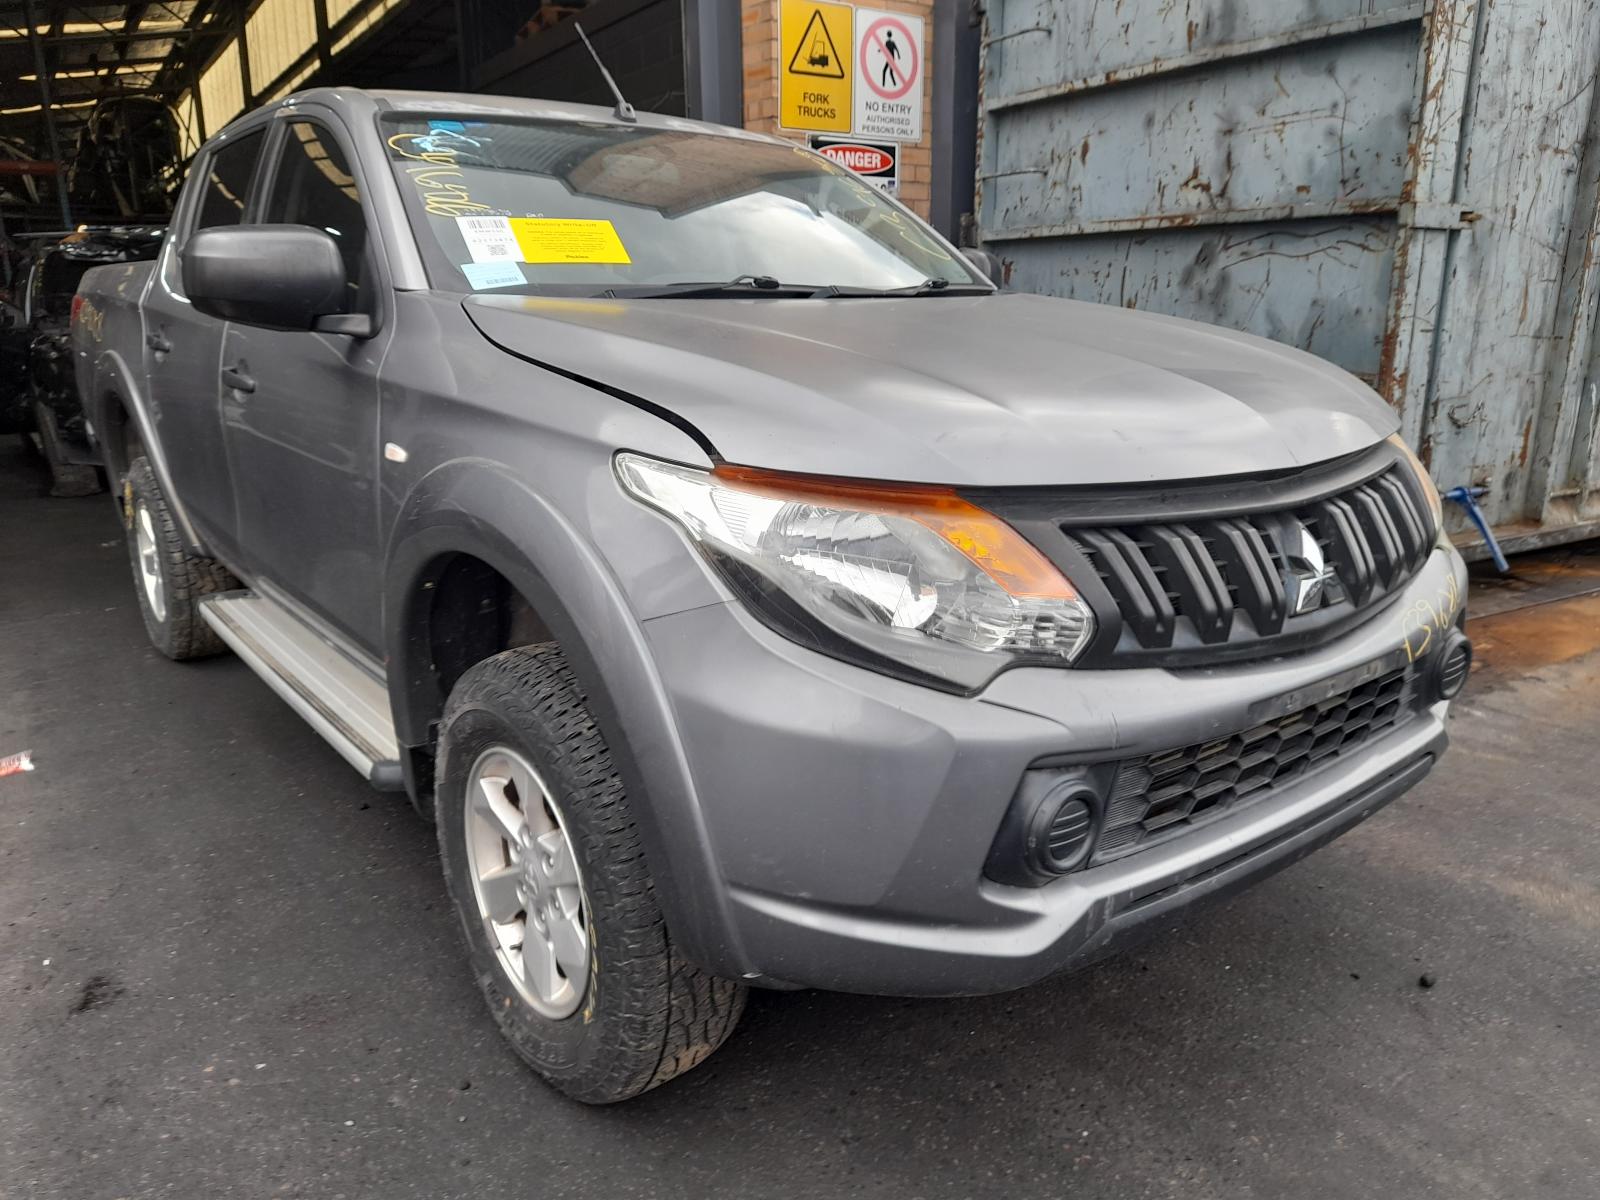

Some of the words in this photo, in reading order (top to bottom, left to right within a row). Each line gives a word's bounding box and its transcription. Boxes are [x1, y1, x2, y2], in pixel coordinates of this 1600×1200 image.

[803, 92, 830, 104] FORK
[798, 105, 836, 119] TRUCKS
[865, 101, 879, 112] NO
[882, 102, 912, 115] ENTRY
[866, 115, 911, 126] AUTHORISED
[862, 124, 895, 134] PERSONS
[896, 126, 914, 136] ONLY
